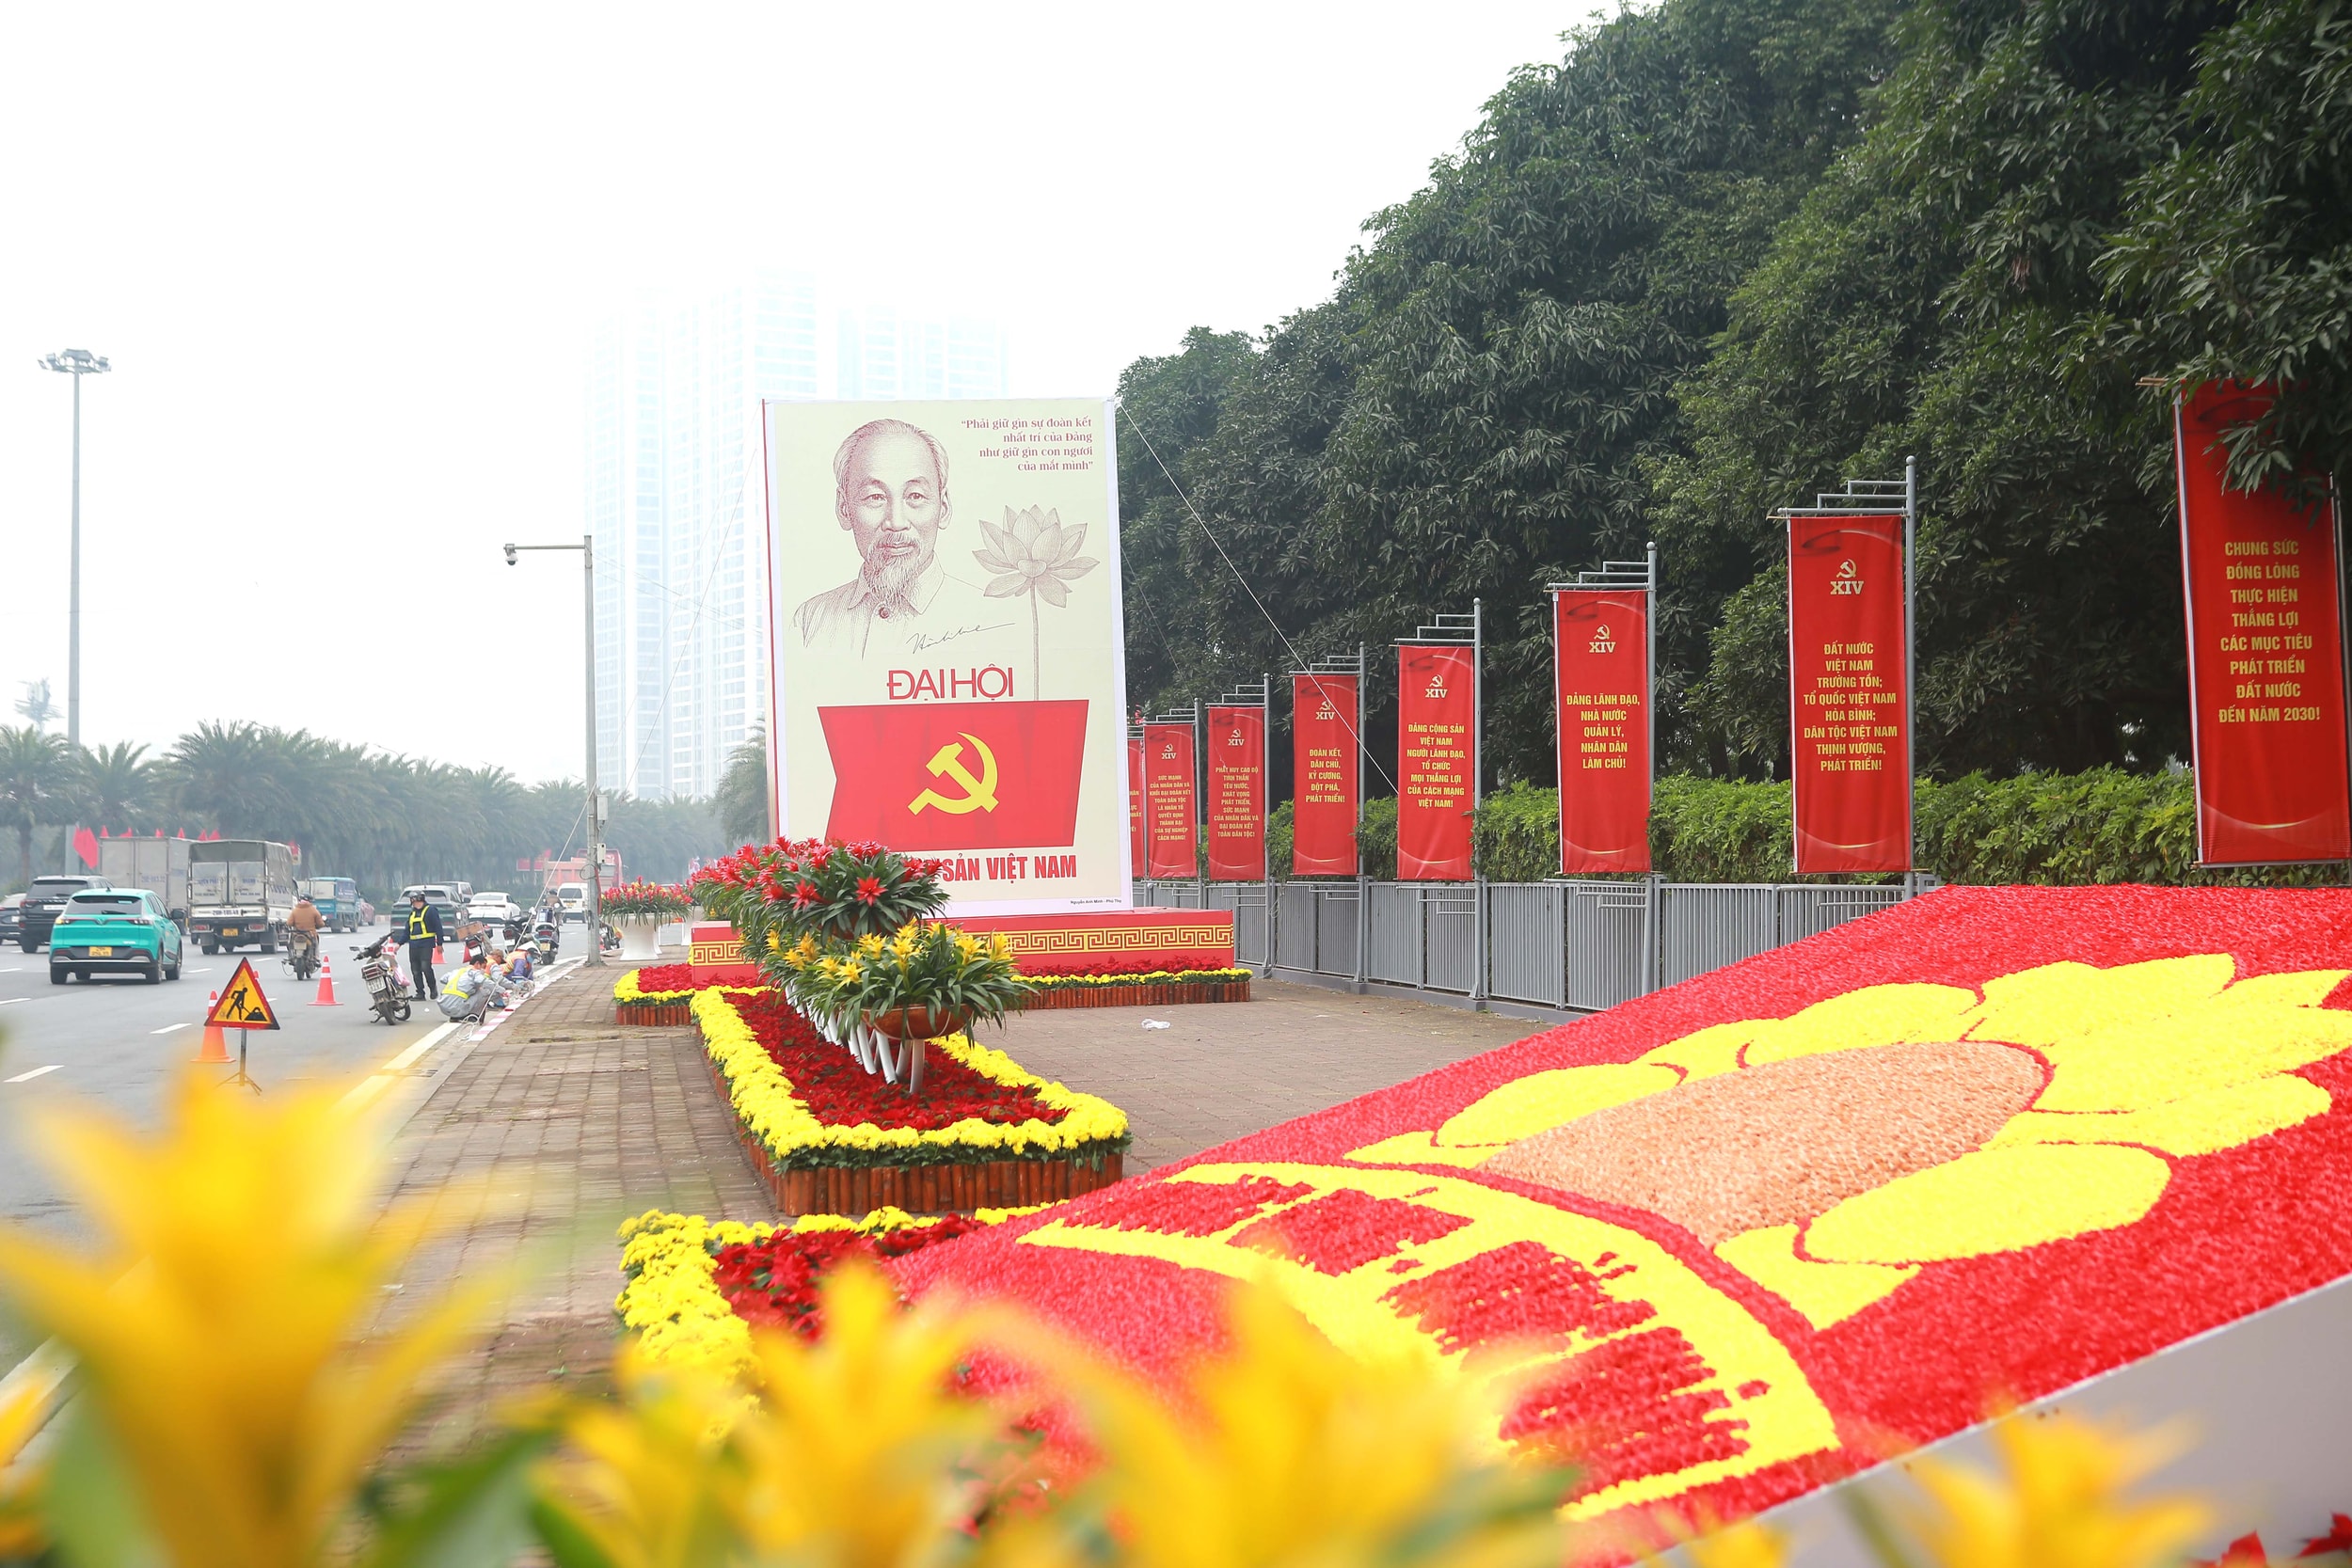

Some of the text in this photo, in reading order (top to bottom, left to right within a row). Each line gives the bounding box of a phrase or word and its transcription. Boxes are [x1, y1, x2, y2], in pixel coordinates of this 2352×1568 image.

[992, 418, 1009, 431] giữ
[1011, 418, 1028, 430] gìn
[1030, 419, 1044, 430] sự
[1046, 417, 1073, 428] đoàn
[1075, 416, 1091, 427] kết
[1003, 431, 1093, 443] nhất trí của Đảng
[979, 447, 1000, 457] như
[1002, 447, 1020, 458] giữ
[1022, 446, 1039, 458] gìn
[1063, 446, 1093, 458] ngươi
[1017, 461, 1037, 471] của
[1040, 458, 1059, 471] mắt
[2224, 540, 2298, 557] CHUNG SỨC
[2225, 562, 2300, 580] ĐỒNG LÒNG
[1830, 580, 1865, 595] XIV
[2230, 586, 2298, 607] THỰC HIỆN
[2231, 609, 2299, 629] THẮNG LỢI
[1588, 641, 1616, 654] XIV
[1823, 640, 1874, 655] ĐẤT NƯỚC
[2220, 632, 2312, 654] CÁC MỤC TIÊU
[1825, 658, 1873, 674] VIỆT NAM
[2230, 654, 2305, 675] PHÁT TRIỂN
[886, 663, 1013, 701] ĐẠI HỘI
[1816, 673, 1883, 689] TRƯỜNG TỒN;
[1424, 688, 1448, 699] XIV
[2235, 679, 2301, 699] ĐẤT NƯỚC
[1566, 691, 1641, 707] ĐẢNG LÃNH ĐẠO,
[1803, 689, 1897, 707] TỔ QUỐC VIỆT NAM
[1315, 711, 1336, 721] XIV
[1581, 708, 1627, 721] NHÀ NƯỚC
[1825, 707, 1876, 721] HÒA BÌNH;
[2217, 704, 2320, 723] ĐẾN NĂM 2030!
[1407, 722, 1465, 735] ĐẢNG CỘNG SẢN
[1583, 722, 1625, 738] QUẢN LÝ,
[1804, 723, 1898, 740] DÂN TỘC VIỆT NAM
[1420, 736, 1453, 747] VIỆT NAM
[1581, 739, 1628, 753] NHÂN DÂN
[1161, 752, 1177, 760] XIV
[1309, 747, 1343, 757] ĐOÀN KẾT,
[1406, 747, 1466, 760] NGƯỜI LÃNH ĐẠO,
[1816, 741, 1886, 758] THỊNH VƯỢNG,
[1310, 759, 1341, 768] DÂN CHỦ,
[1422, 760, 1451, 770] TỔ CHỨC
[1582, 754, 1627, 769] LÀM CHỦ!
[1820, 756, 1883, 771] PHÁT TRIỂN!
[1308, 771, 1343, 781] KỶ CƯƠNG,
[1410, 772, 1462, 784] MỌI THẮNG LỢI
[1311, 782, 1341, 793] ĐỘT PHÁ,
[1406, 784, 1465, 798] CỦA CÁCH MẠNG
[1305, 793, 1345, 803] PHÁT TRIỂN!
[1418, 798, 1454, 809] VIỆT NAM!
[942, 852, 980, 882] SẢN
[986, 852, 1028, 884] VIỆT
[1034, 855, 1077, 879] NAM
